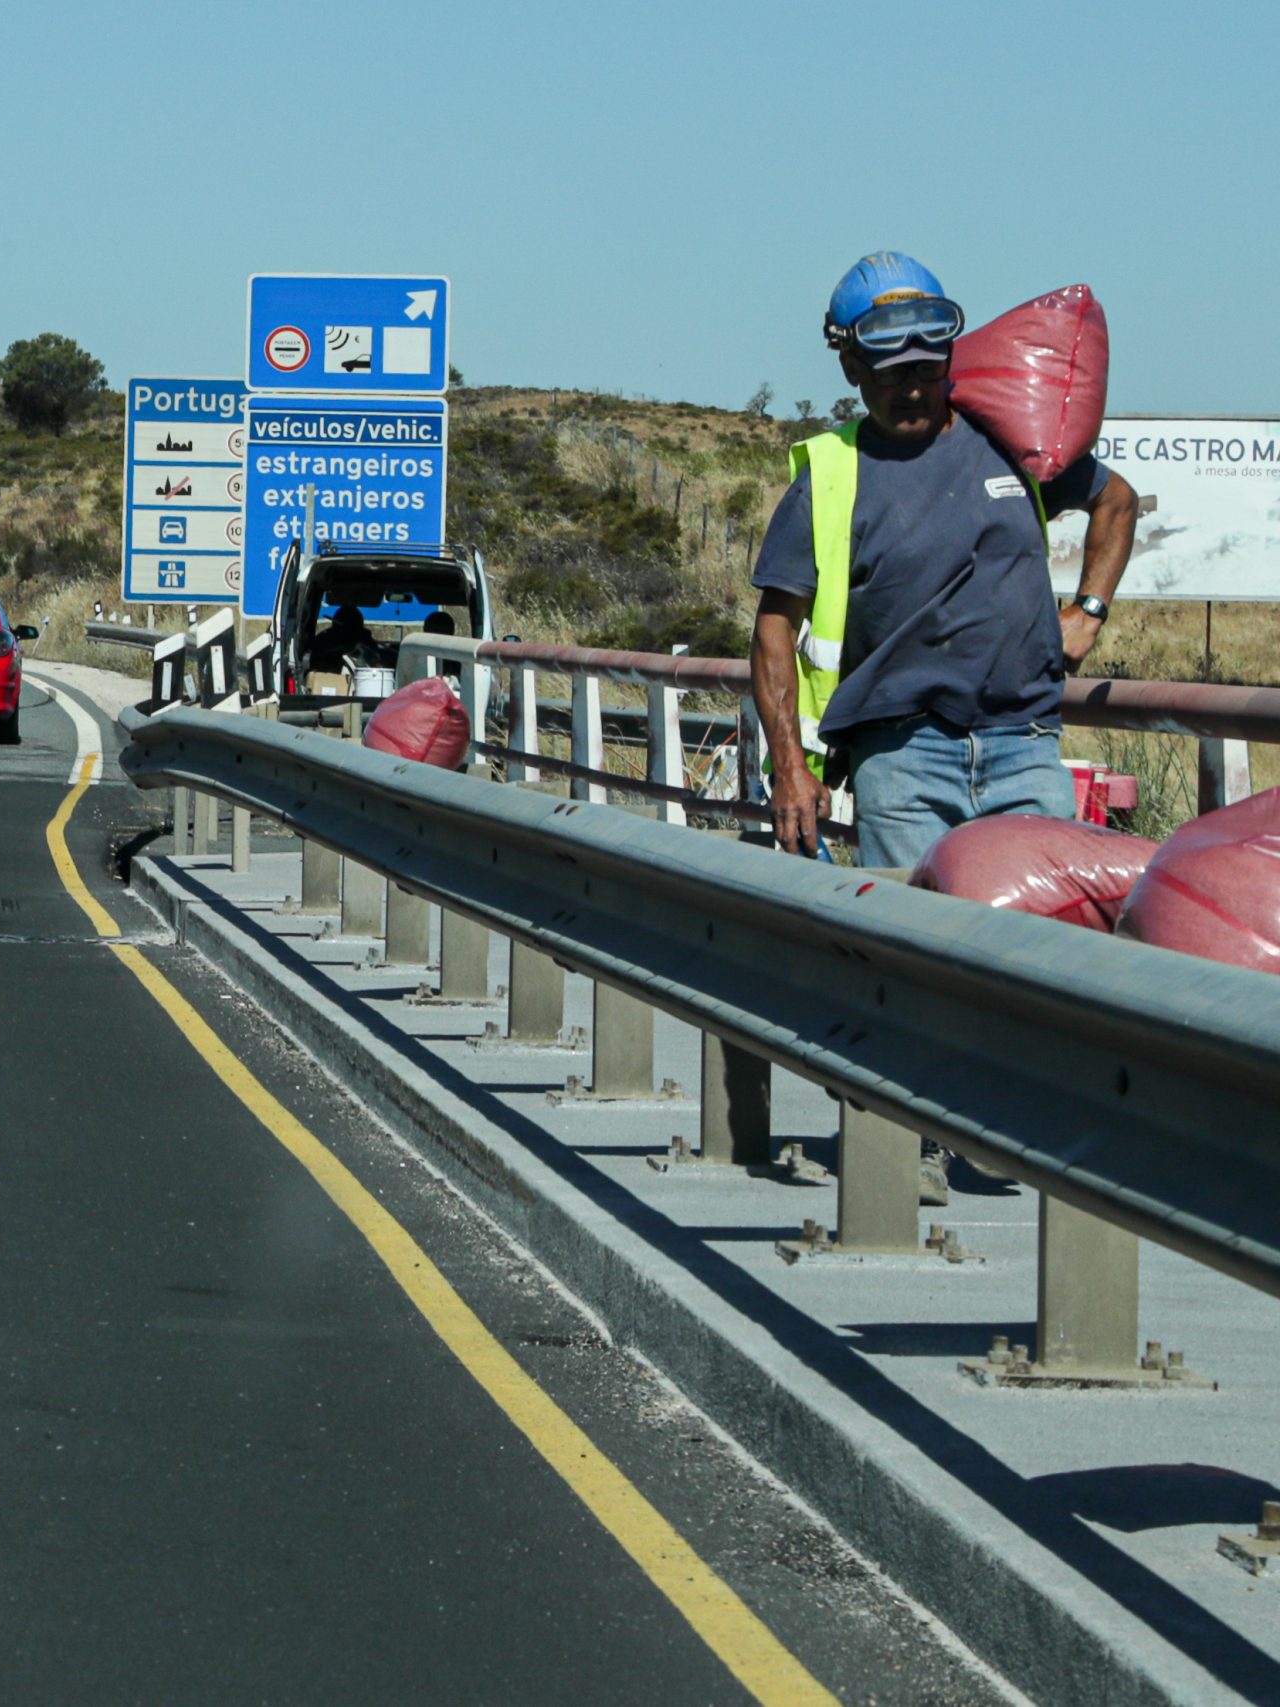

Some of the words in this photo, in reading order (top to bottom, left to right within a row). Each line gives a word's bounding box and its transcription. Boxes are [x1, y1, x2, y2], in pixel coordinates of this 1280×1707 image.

[254, 417, 439, 442] veículos/vehic.
[1095, 437, 1127, 460] DE
[1134, 437, 1246, 462] CASTRO
[1252, 439, 1280, 462] M
[256, 451, 433, 480] estrangeiros
[1205, 468, 1237, 477] mesa
[1241, 466, 1262, 477] dos
[230, 527, 241, 536] 10
[272, 515, 410, 542] étangers
[229, 571, 240, 580] 12
